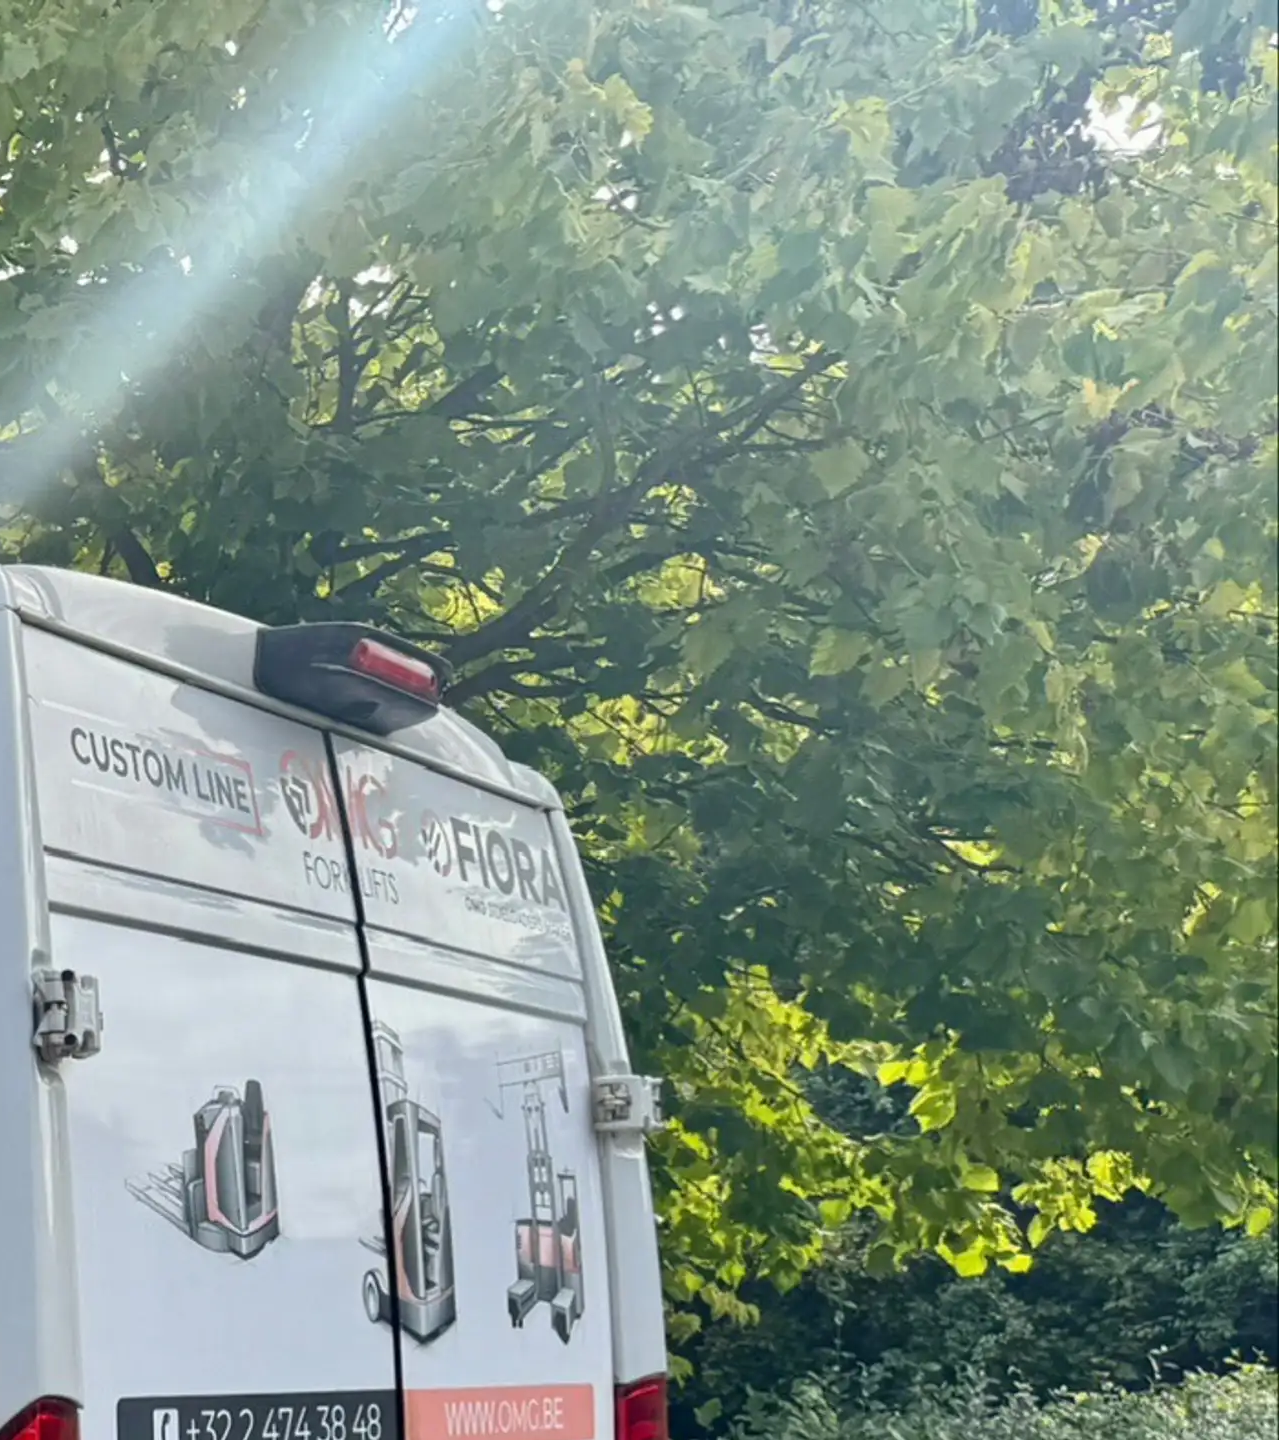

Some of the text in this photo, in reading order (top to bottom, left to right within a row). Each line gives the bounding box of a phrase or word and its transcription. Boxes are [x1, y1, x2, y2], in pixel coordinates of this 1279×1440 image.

[70, 727, 251, 814] CUSTOM LINE
[450, 816, 568, 912] FIORA
[444, 1397, 565, 1436] WWW.OMG.BE
